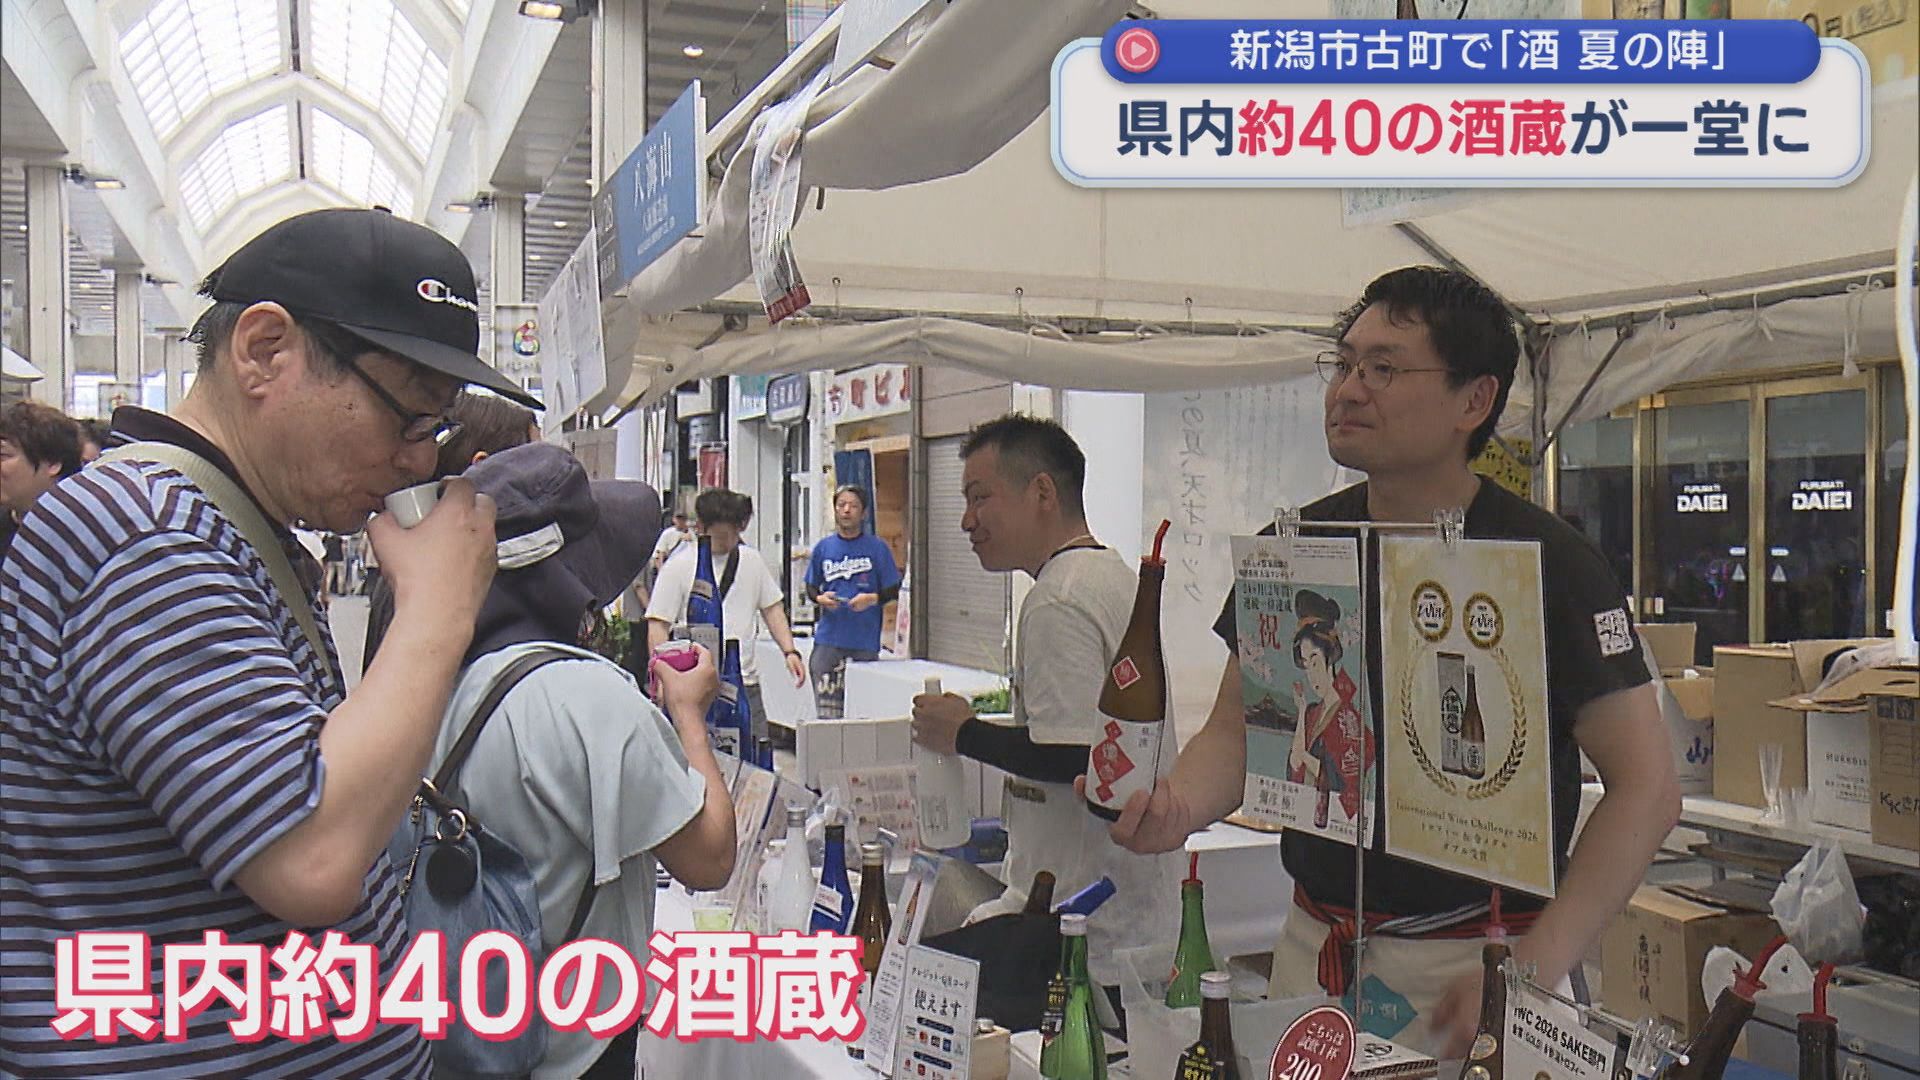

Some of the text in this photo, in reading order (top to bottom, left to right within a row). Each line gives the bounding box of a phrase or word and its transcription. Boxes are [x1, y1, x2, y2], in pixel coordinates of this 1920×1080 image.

[1676, 493, 1728, 512] DAIEI
[1791, 491, 1852, 511] DAIEI
[822, 555, 873, 582] Dodgers
[1258, 612, 1281, 651] 祝
[1396, 800, 1446, 820] International
[1447, 811, 1469, 826] Wine
[1470, 816, 1514, 837] Challenge
[914, 986, 962, 1018] 使えます
[1307, 1022, 1345, 1046] こちらは
[1534, 1014, 1559, 1043] 2026
[1279, 1052, 1323, 1080] 200
